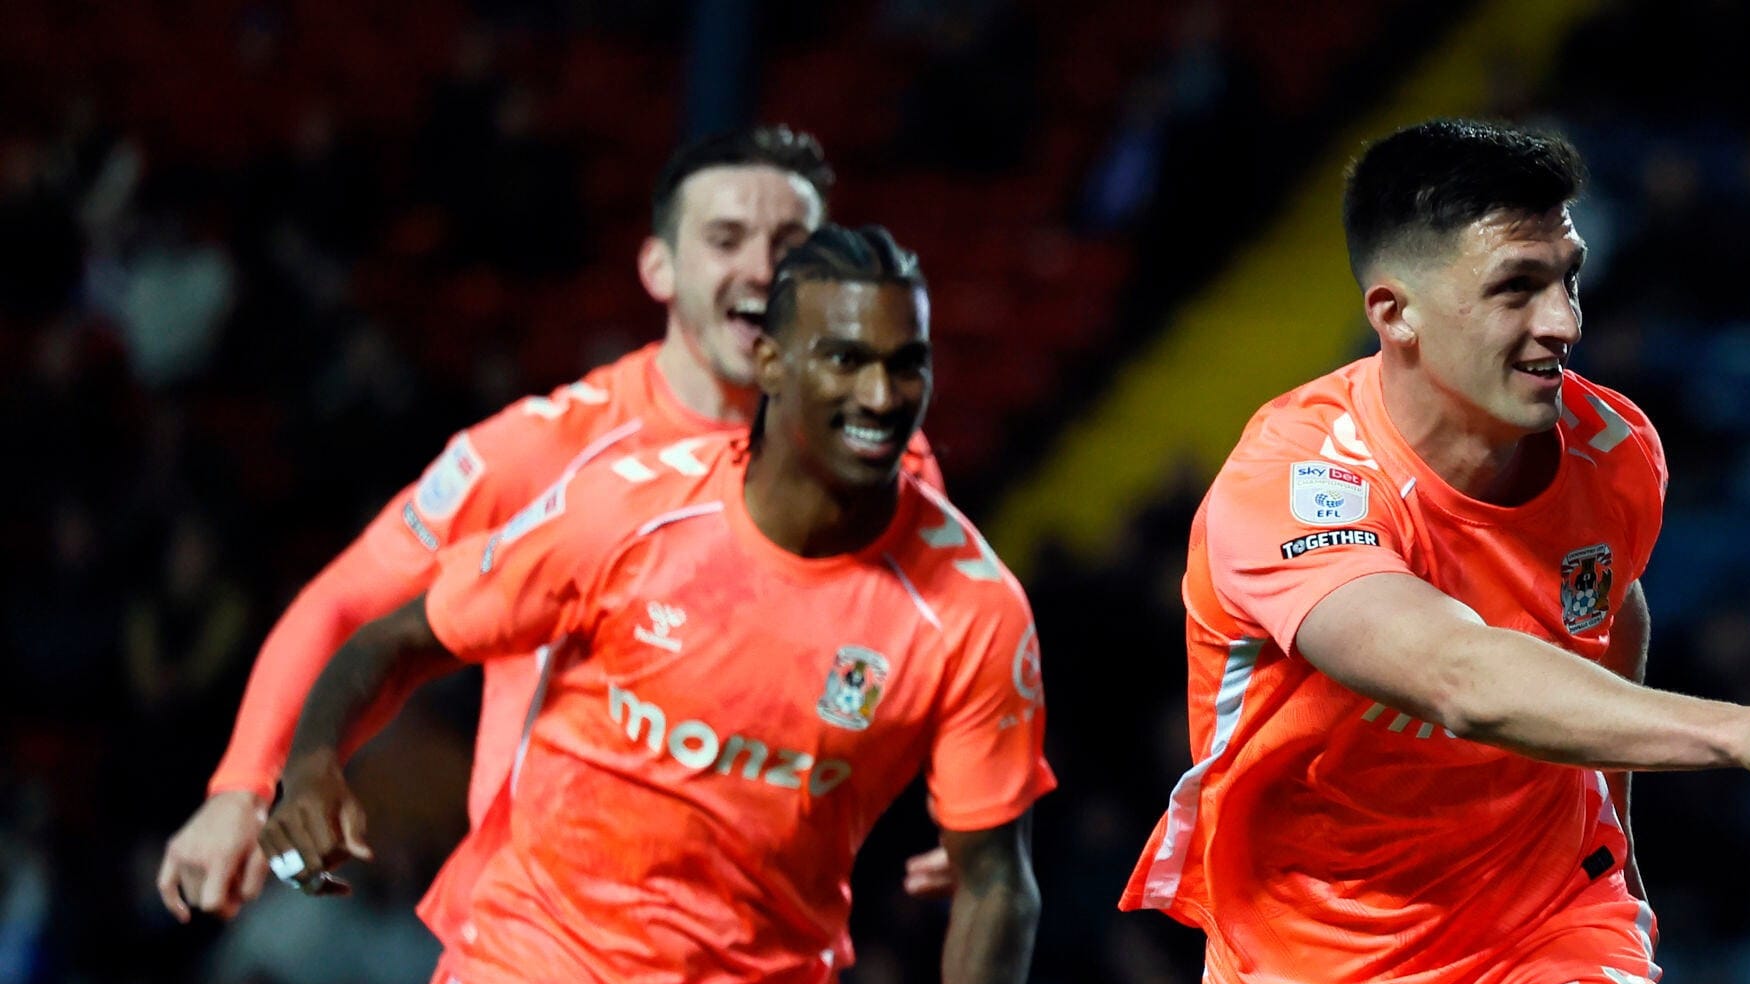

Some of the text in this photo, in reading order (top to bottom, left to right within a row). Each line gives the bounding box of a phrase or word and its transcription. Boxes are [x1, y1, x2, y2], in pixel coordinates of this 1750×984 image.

[1298, 466, 1362, 485] sky bet
[1316, 509, 1342, 518] EFL
[1281, 530, 1378, 560] TOGETHER
[609, 685, 851, 797] monzo
